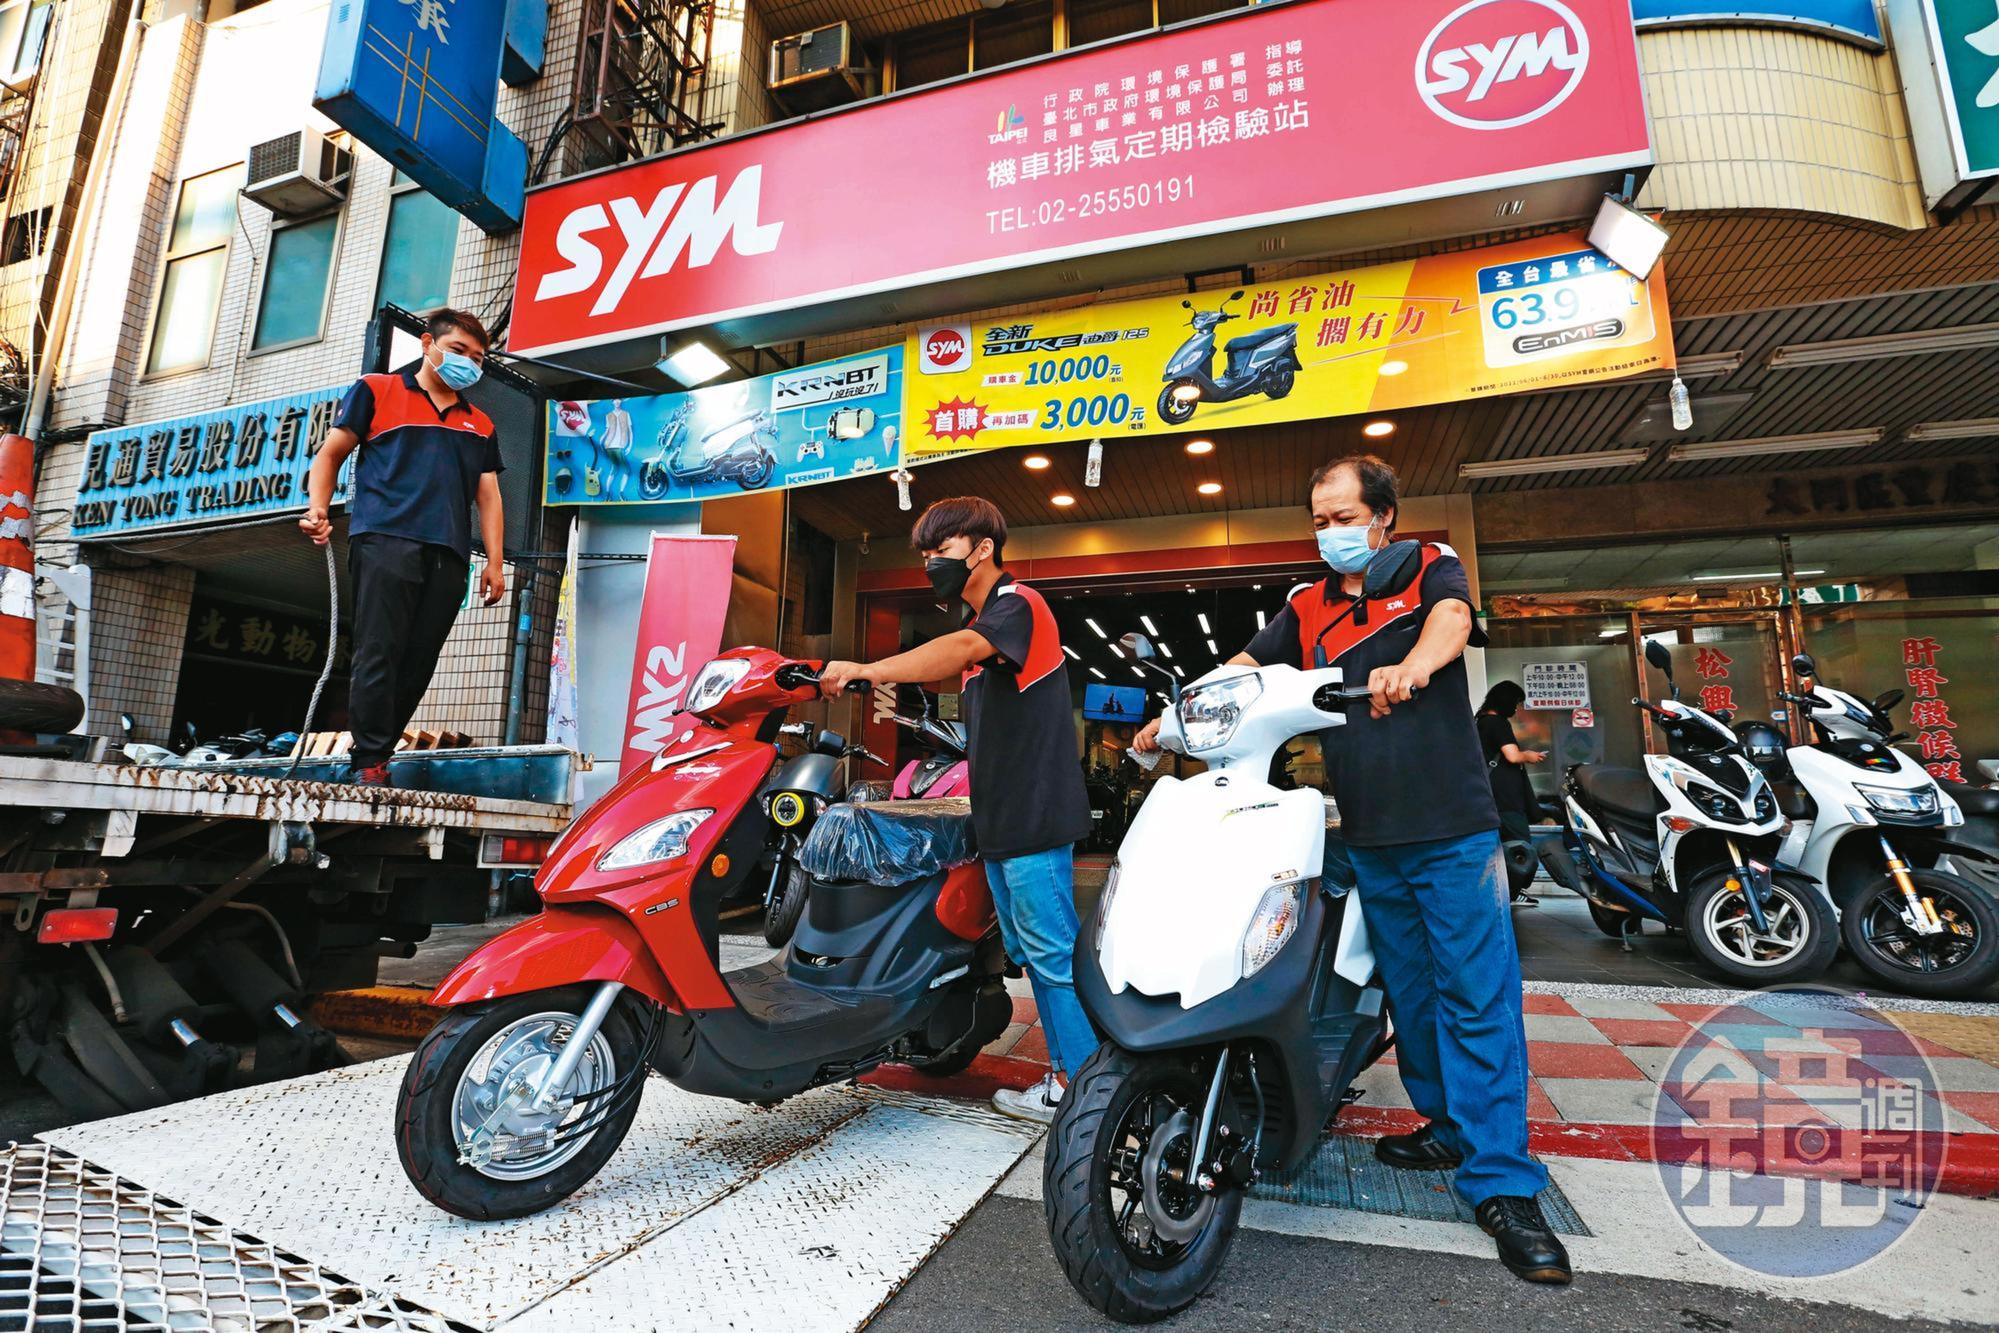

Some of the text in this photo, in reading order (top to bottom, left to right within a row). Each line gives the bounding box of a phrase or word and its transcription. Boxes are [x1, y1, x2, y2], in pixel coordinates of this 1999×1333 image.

[1043, 52, 1246, 109] 行政院環境保護署
[1425, 26, 1580, 103] SYM
[987, 99, 1310, 190] 機車排氣定期檢驗站
[988, 127, 1028, 144] TAIPEI
[986, 174, 1195, 234] TEL:02-25550191
[534, 164, 784, 317] SYM
[1495, 256, 1617, 287] 全台最省
[1248, 280, 1356, 320] 尚省油
[927, 339, 965, 360] SYM
[985, 324, 1034, 342] 全新
[985, 336, 1081, 355] DUKE
[1122, 328, 1149, 341] 125
[777, 365, 880, 397] KRNBT
[935, 409, 979, 433] 首購
[992, 412, 1029, 426] 再加碼
[71, 500, 116, 528] KEN
[121, 490, 179, 521] TONG
[185, 472, 292, 513] TRADING
